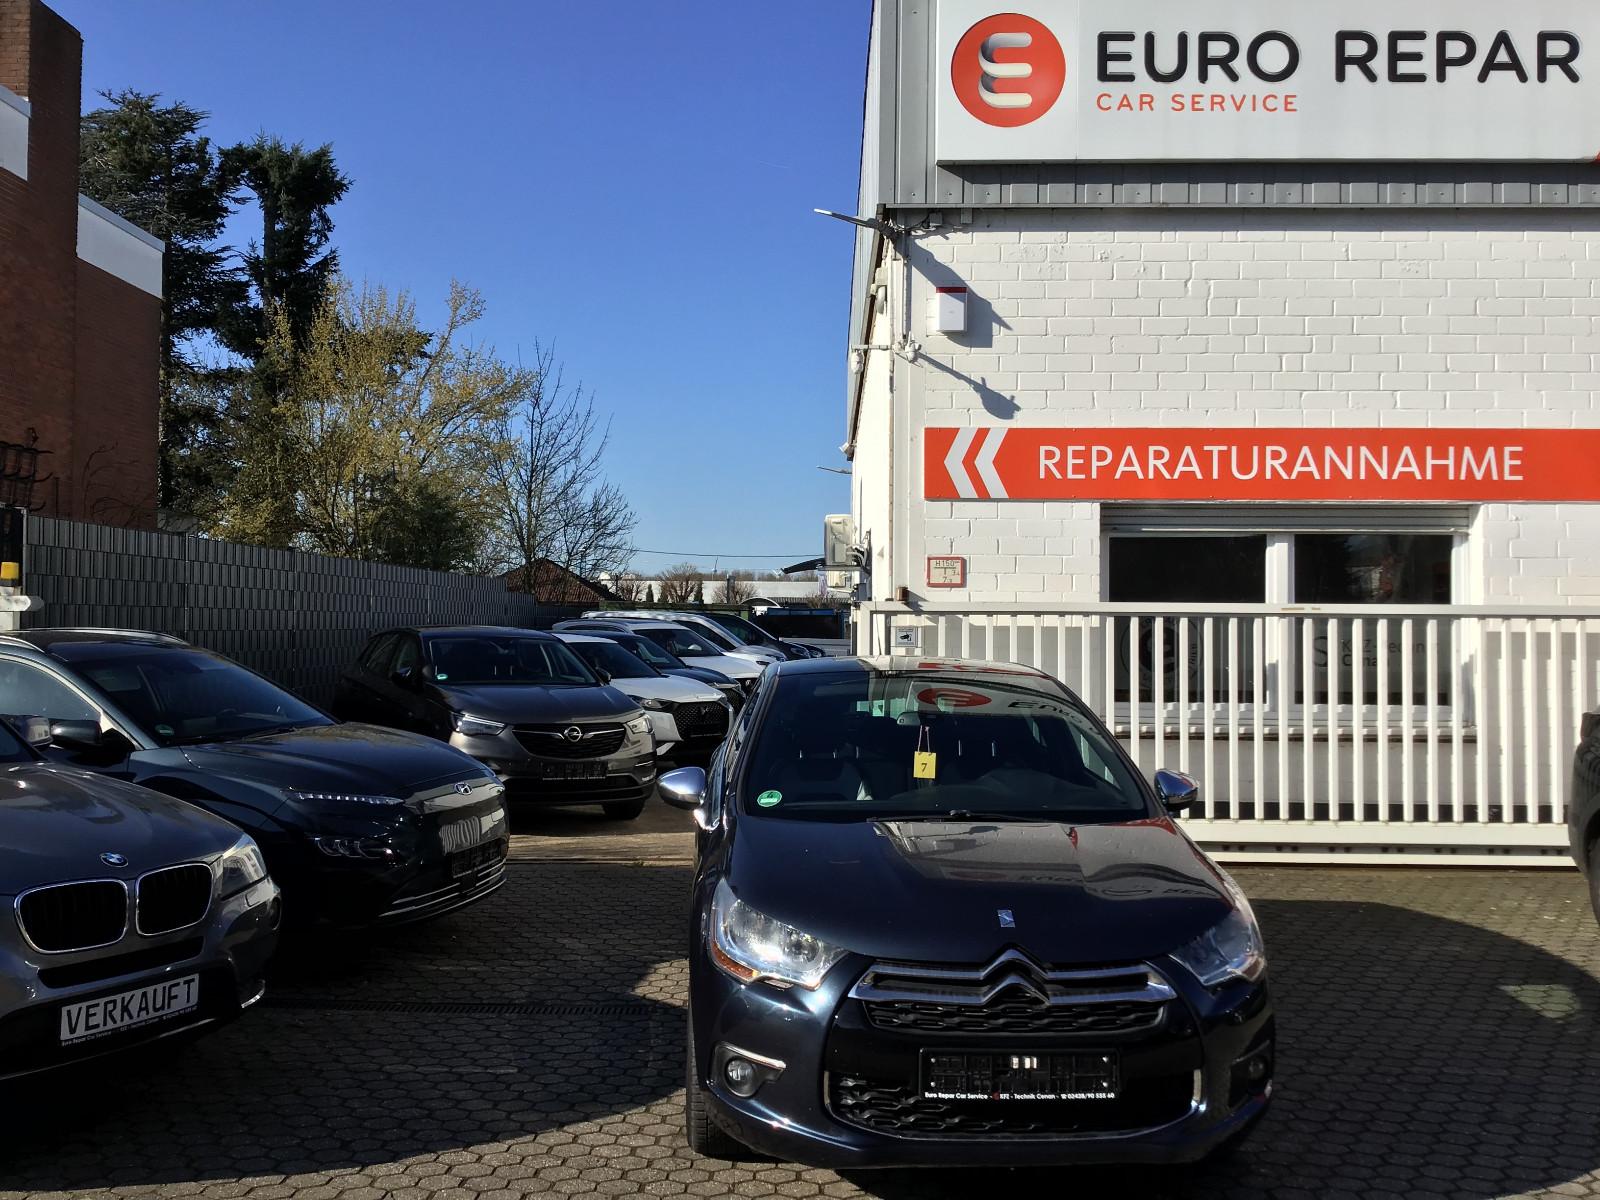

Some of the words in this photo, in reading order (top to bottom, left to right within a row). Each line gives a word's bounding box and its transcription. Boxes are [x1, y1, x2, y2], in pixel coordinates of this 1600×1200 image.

[1096, 30, 1300, 84] EURO
[1335, 30, 1580, 84] REPAR
[1096, 93, 1155, 113] CAR
[1170, 93, 1298, 113] SERVICE
[1038, 444, 1524, 482] REPARATURANNAHME
[921, 762, 928, 773] 7
[66, 977, 196, 1035] VERKAUFT
[925, 1091, 938, 1099] Euro
[955, 1092, 967, 1100] Car
[967, 1092, 988, 1100] Service
